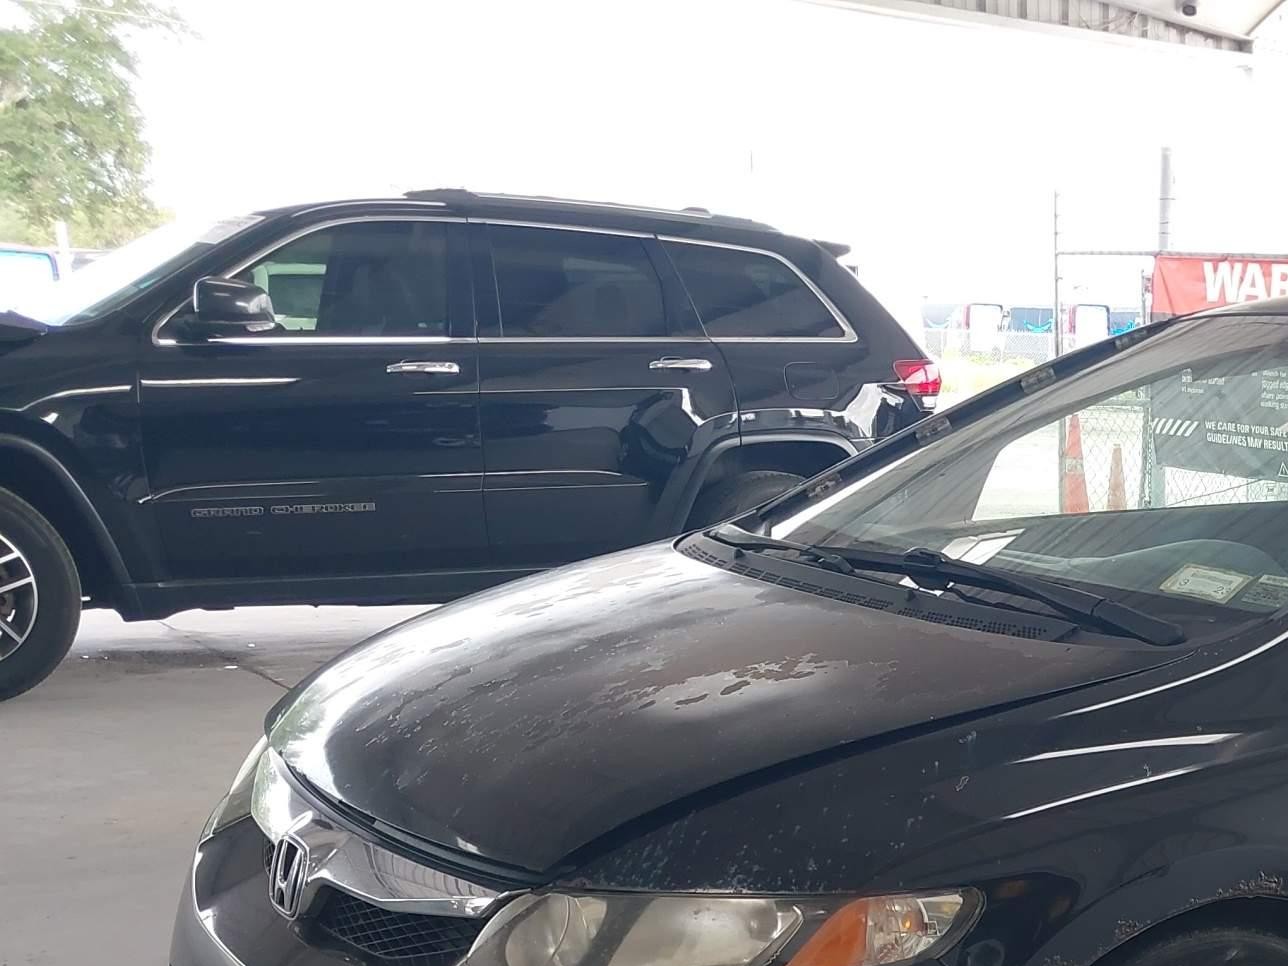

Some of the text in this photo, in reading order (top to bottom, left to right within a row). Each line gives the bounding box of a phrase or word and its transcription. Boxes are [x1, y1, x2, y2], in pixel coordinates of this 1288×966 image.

[1205, 420, 1216, 430] WE
[1217, 422, 1237, 432] CARE
[1237, 423, 1250, 433] FOR
[1251, 425, 1269, 435] YOUR
[1206, 432, 1247, 447] GUIDELINES
[1247, 437, 1263, 449] MAY
[1263, 439, 1288, 452] RESULT
[191, 502, 376, 518] GRAND CHEROKEE
